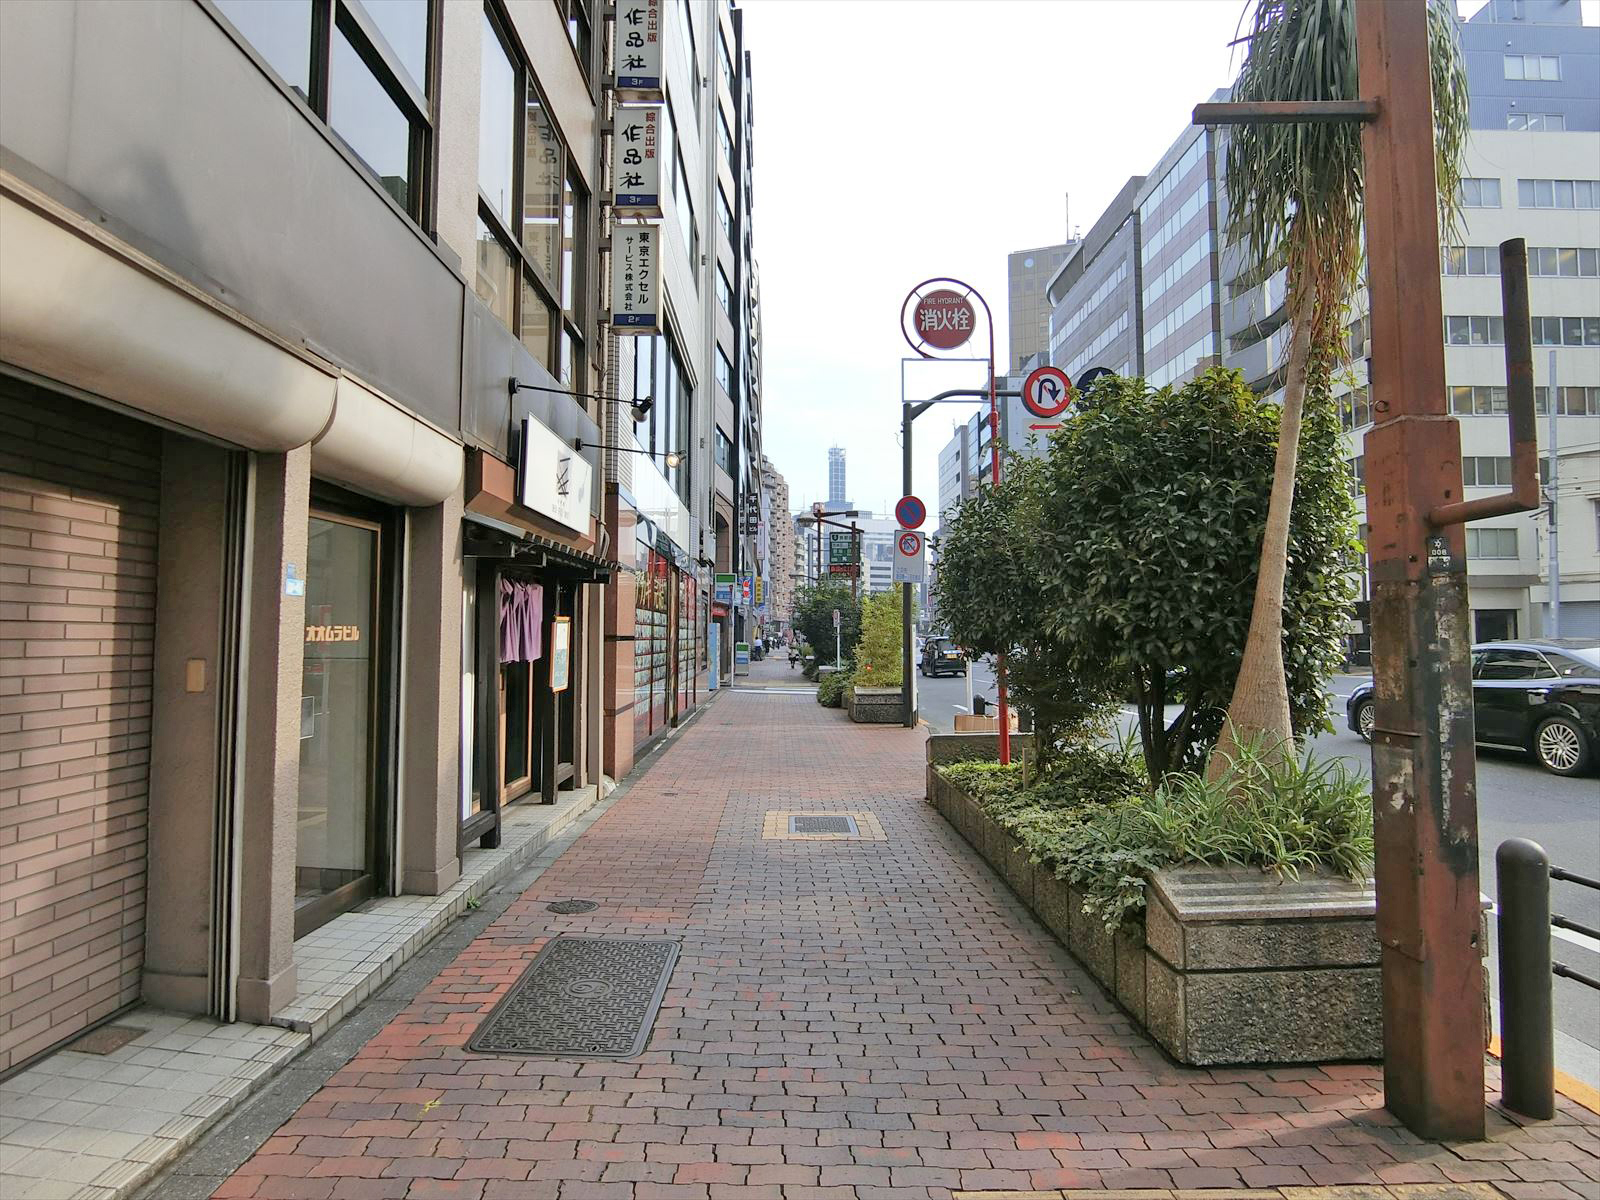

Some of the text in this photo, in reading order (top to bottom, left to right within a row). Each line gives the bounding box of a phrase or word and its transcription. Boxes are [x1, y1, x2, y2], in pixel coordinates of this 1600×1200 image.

[621, 8, 646, 71] 作品社
[631, 78, 643, 86] 3F
[645, 112, 656, 159] 綜合出版
[619, 123, 645, 189] 作品社
[629, 195, 641, 204] 3F
[624, 235, 634, 311] サービス株式会社
[638, 232, 650, 304] 東京エクセル
[628, 315, 640, 323] 2F
[920, 307, 970, 331] 消火栓
[305, 625, 360, 642] オオムラビル
